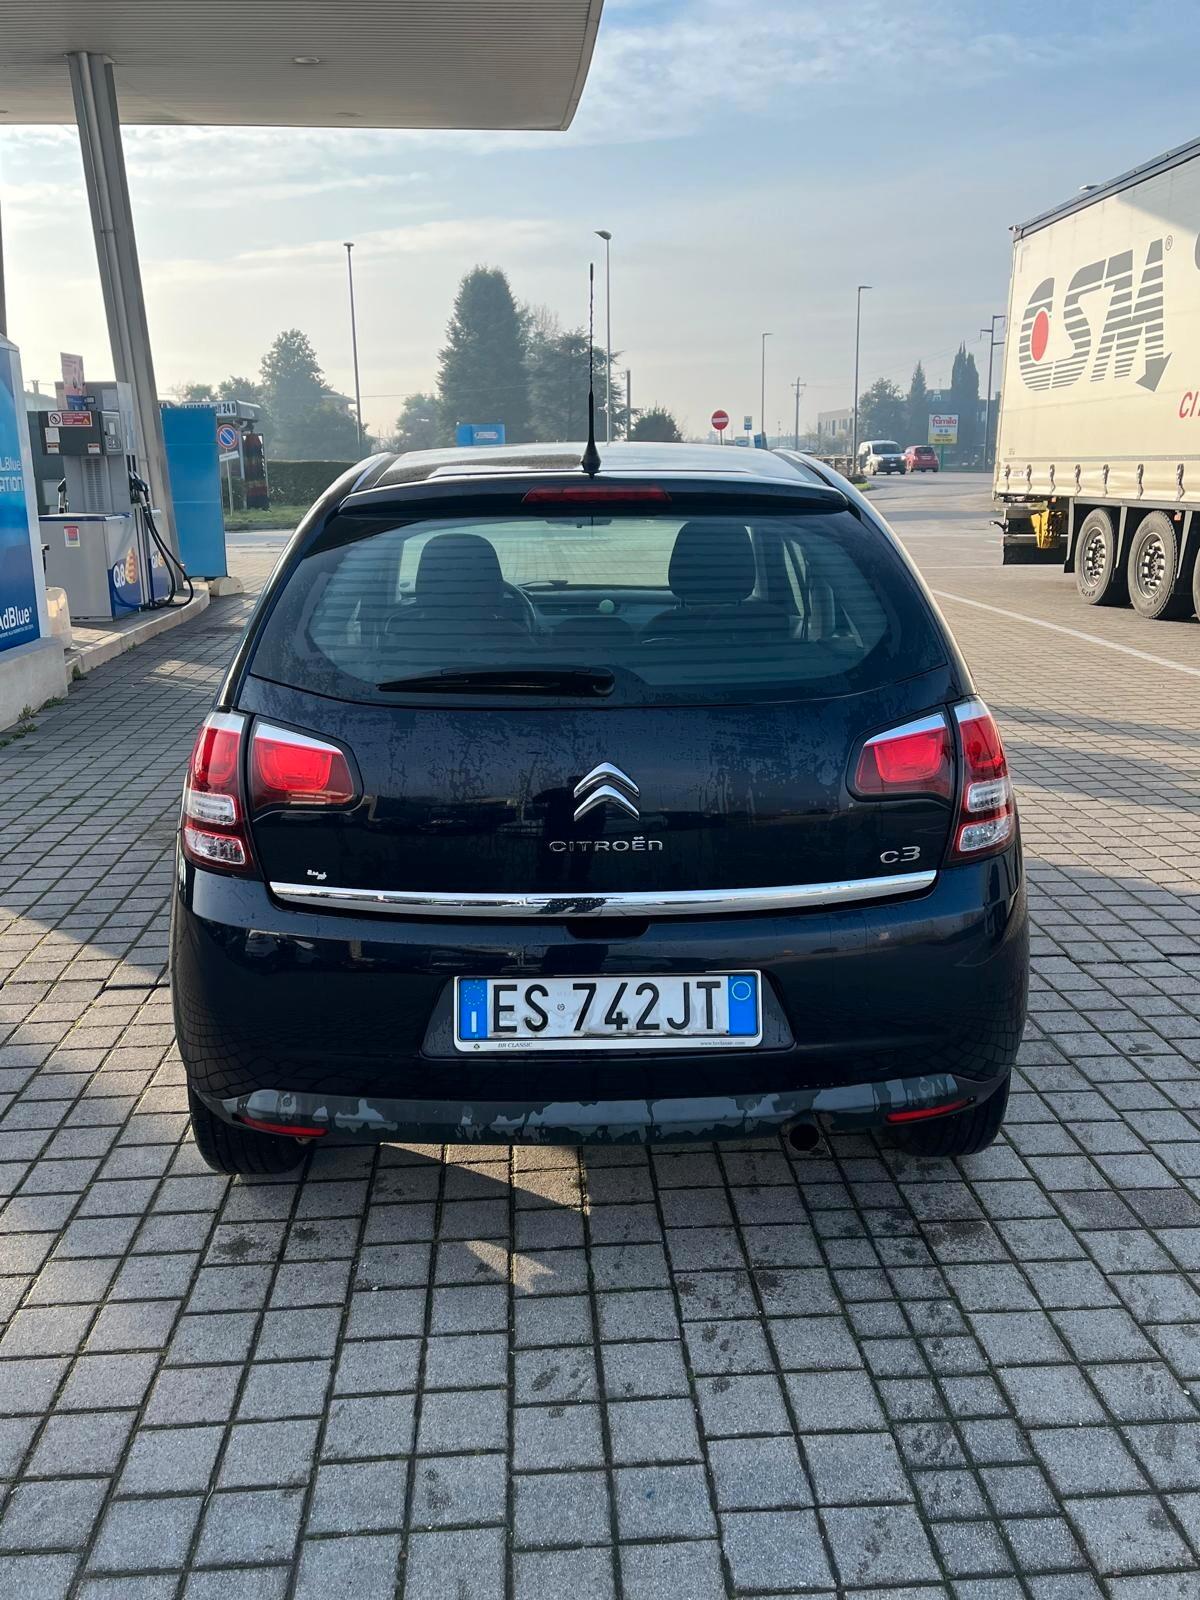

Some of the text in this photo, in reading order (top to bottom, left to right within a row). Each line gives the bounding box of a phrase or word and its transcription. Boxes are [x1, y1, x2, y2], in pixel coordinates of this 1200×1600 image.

[1179, 391, 1200, 418] CI
[113, 563, 126, 588] Q8
[880, 846, 920, 864] C3
[493, 981, 721, 1033] ES 742JT
